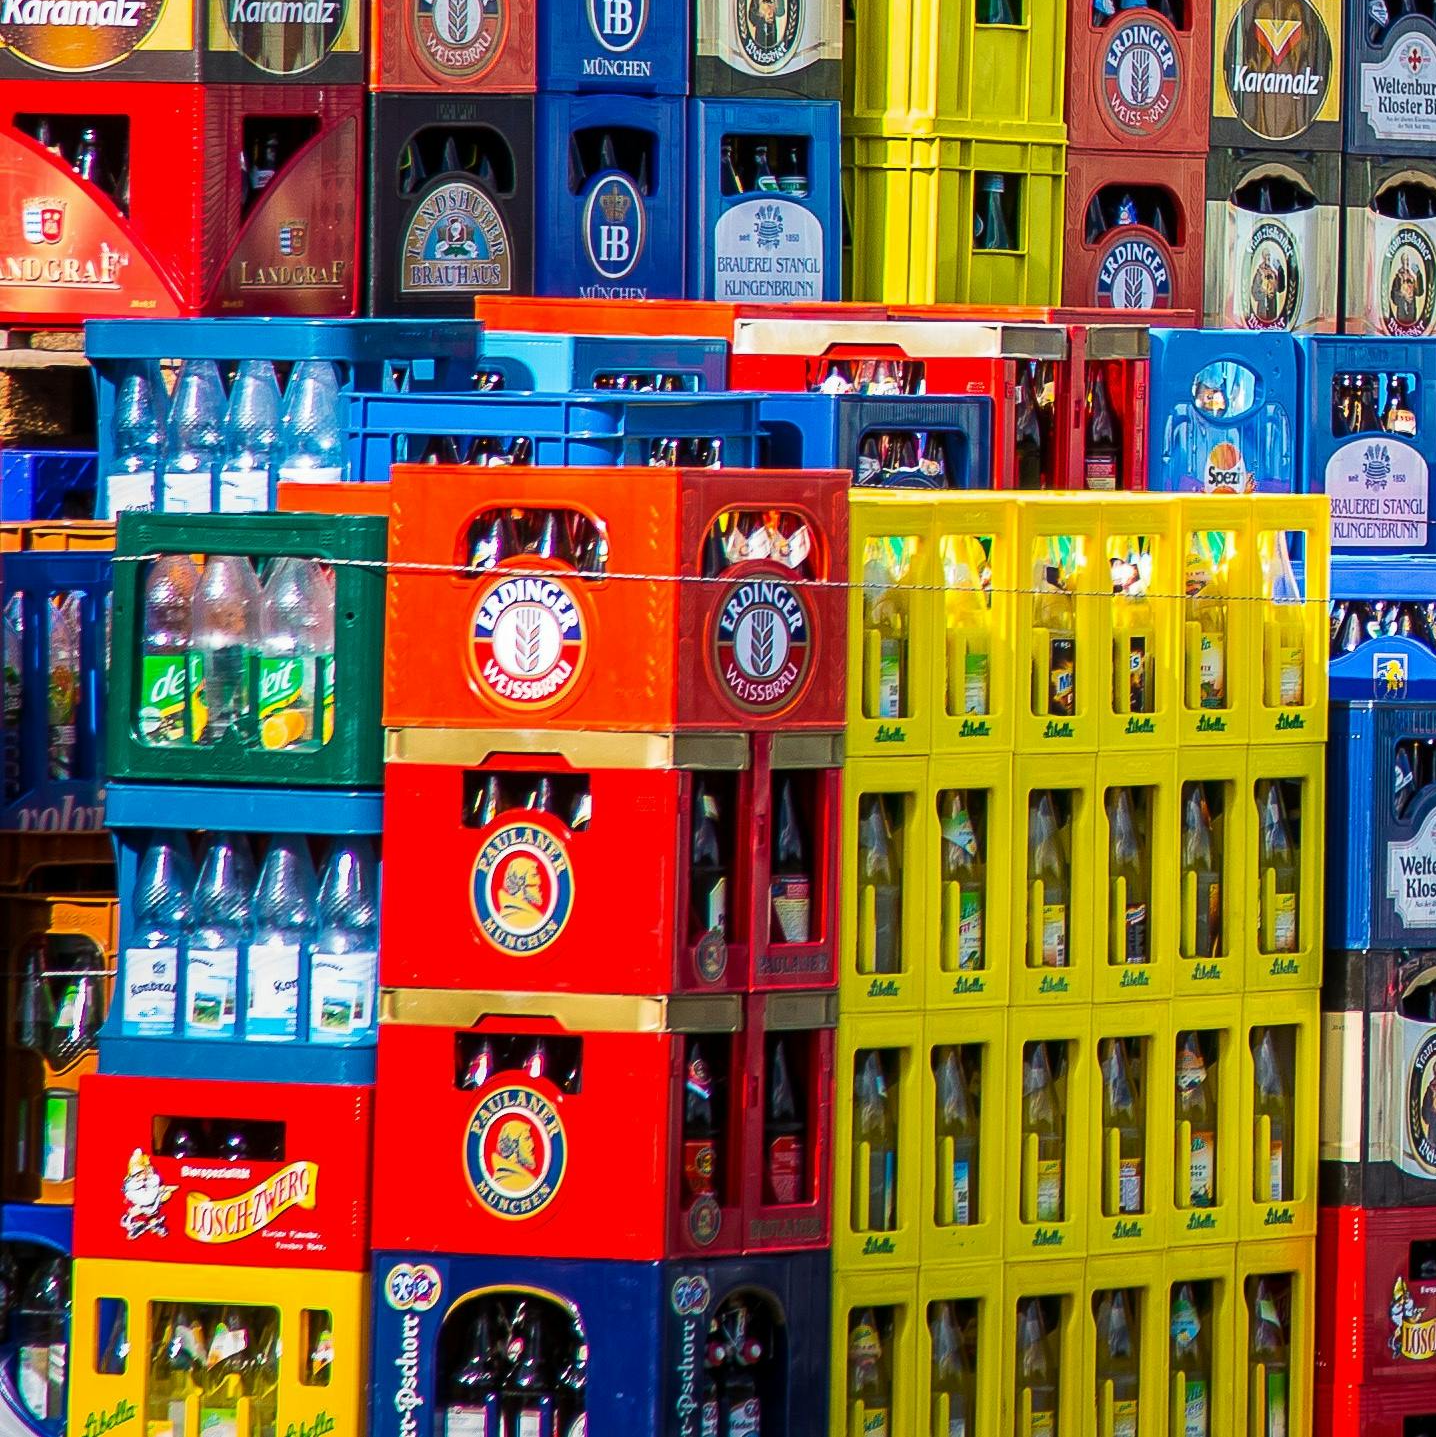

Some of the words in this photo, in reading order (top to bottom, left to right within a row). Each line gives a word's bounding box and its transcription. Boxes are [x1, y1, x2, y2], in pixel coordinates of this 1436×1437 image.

[582, 58, 651, 78] MÜNCHEN
[239, 260, 345, 286] LANDGRAF
[411, 264, 501, 286] BRAUHAUS
[478, 577, 579, 632] ERDINGER
[469, 1090, 560, 1136] PAULANER
[188, 1164, 313, 1237] LÖSCH-ZWERG
[476, 1183, 552, 1216] MÜNCHEN
